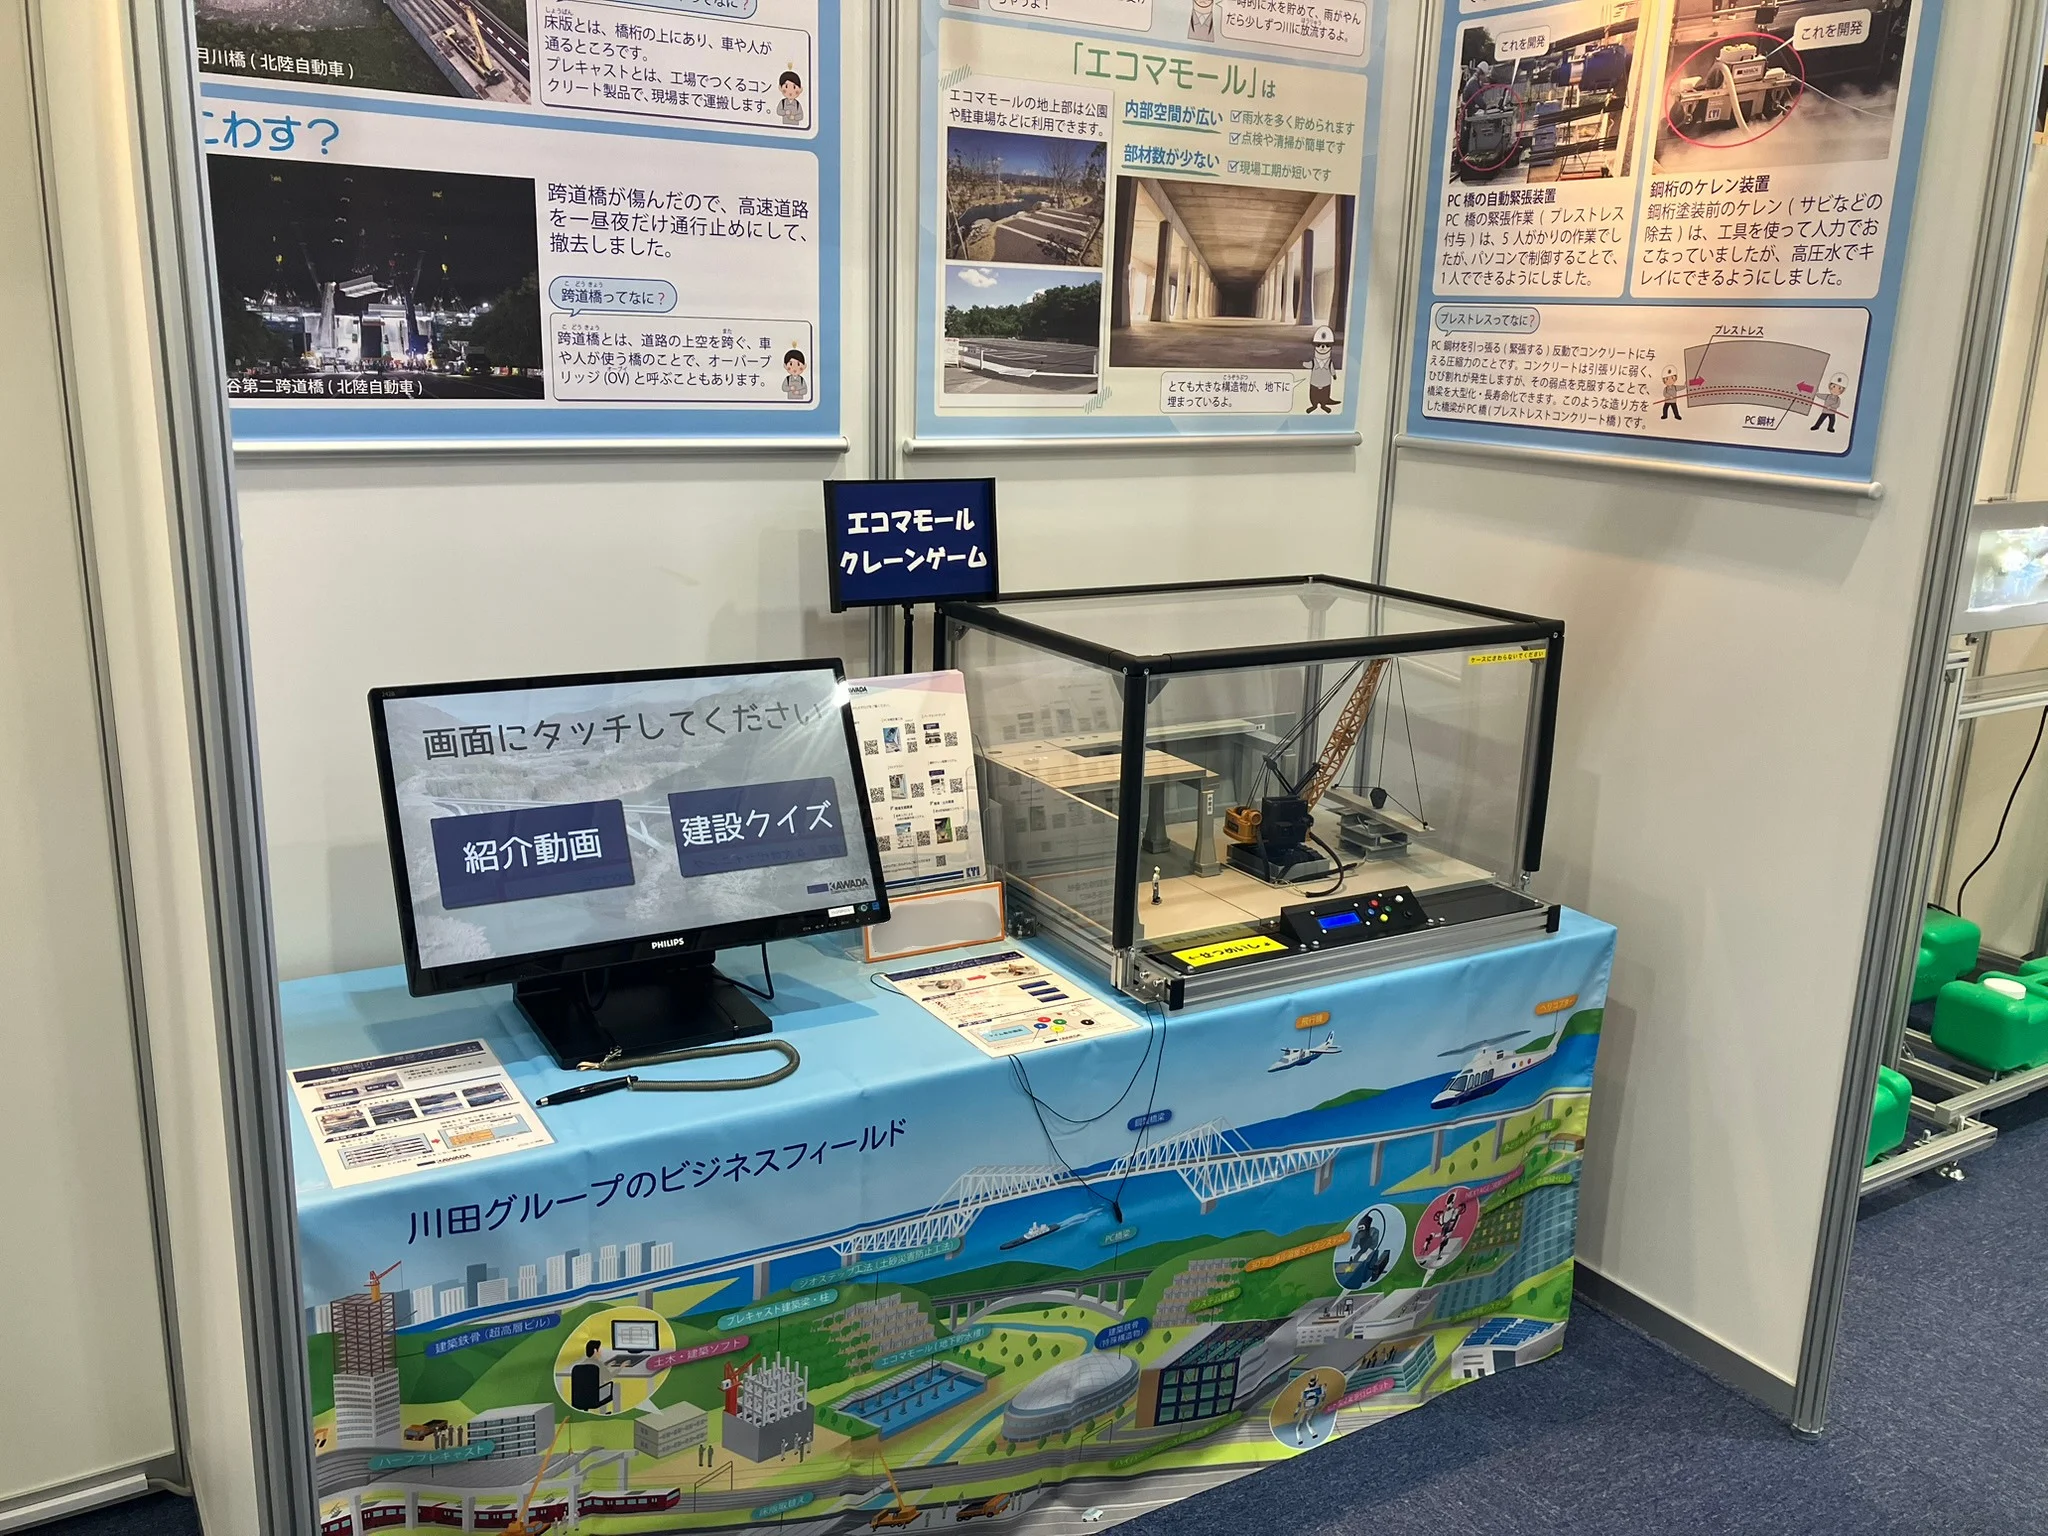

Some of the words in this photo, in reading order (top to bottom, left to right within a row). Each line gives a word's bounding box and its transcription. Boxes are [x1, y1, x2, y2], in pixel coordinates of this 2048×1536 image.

[544, 16, 772, 56] 床版とは、橋桁の上にあり、車や人が
[1226, 13, 1348, 43] だら少しずつ川に放流するよ。
[1802, 20, 1863, 41] これを開発
[545, 36, 650, 62] 通るところです。
[1501, 35, 1545, 53] これを開発
[547, 58, 772, 95] プレキャストとは、工場でつくるコン
[547, 79, 772, 115] クリート製品で、現場まで運搬します。
[950, 89, 1108, 118] エコマモールの地上部は公園
[949, 108, 1104, 138] や駐車場などに利用できます。
[1125, 99, 1224, 127] 内部空間が広い
[1242, 110, 1356, 135] 雨水を多く貯められます
[1241, 132, 1346, 154] 点検や清掃が簡単です
[1124, 144, 1220, 169] 部材数が少ない
[1239, 162, 1332, 182] 現場工期が短いです
[1650, 175, 1770, 199] 鋼桁のケレン装置
[548, 183, 809, 220] 跨道橋が傷んだので、高速道路
[549, 208, 808, 243] を一昼夜だけ通行止めにして、
[549, 232, 672, 259] 撤去しました。
[1642, 243, 1875, 264] こなっていましたが、高圧水でキ
[1442, 250, 1618, 267] たが、パソコンで制御することで、
[1640, 267, 1843, 287] レイにできるようにしました。
[561, 288, 665, 306] 跨道橋ってなに?
[1441, 312, 1535, 328] プレストレスってなに?
[1715, 325, 1764, 336] プレストレス
[557, 331, 772, 351] 跨道橋とは、道路の上空を跨ぐ、車
[558, 351, 772, 369] や人が使う橋のことで、オーバーブ
[1168, 380, 1290, 394] とても大きな構造物が、地下に
[1167, 396, 1233, 408] 埋まっているよ。
[848, 507, 975, 535] エコマモール
[840, 545, 988, 575] クレーンゲーム
[1470, 651, 1545, 664] ケースにさわらないでください
[422, 702, 823, 761] 画面にタッチしてください
[680, 800, 834, 847] 建設クイズ
[463, 828, 602, 875] 紹介動画
[828, 878, 869, 892] KAWADA
[651, 937, 685, 950] PHILIPS
[408, 1118, 908, 1244] 川田グループのビジネスフィールド
[379, 1446, 485, 1466] ハーフプレキャスト
